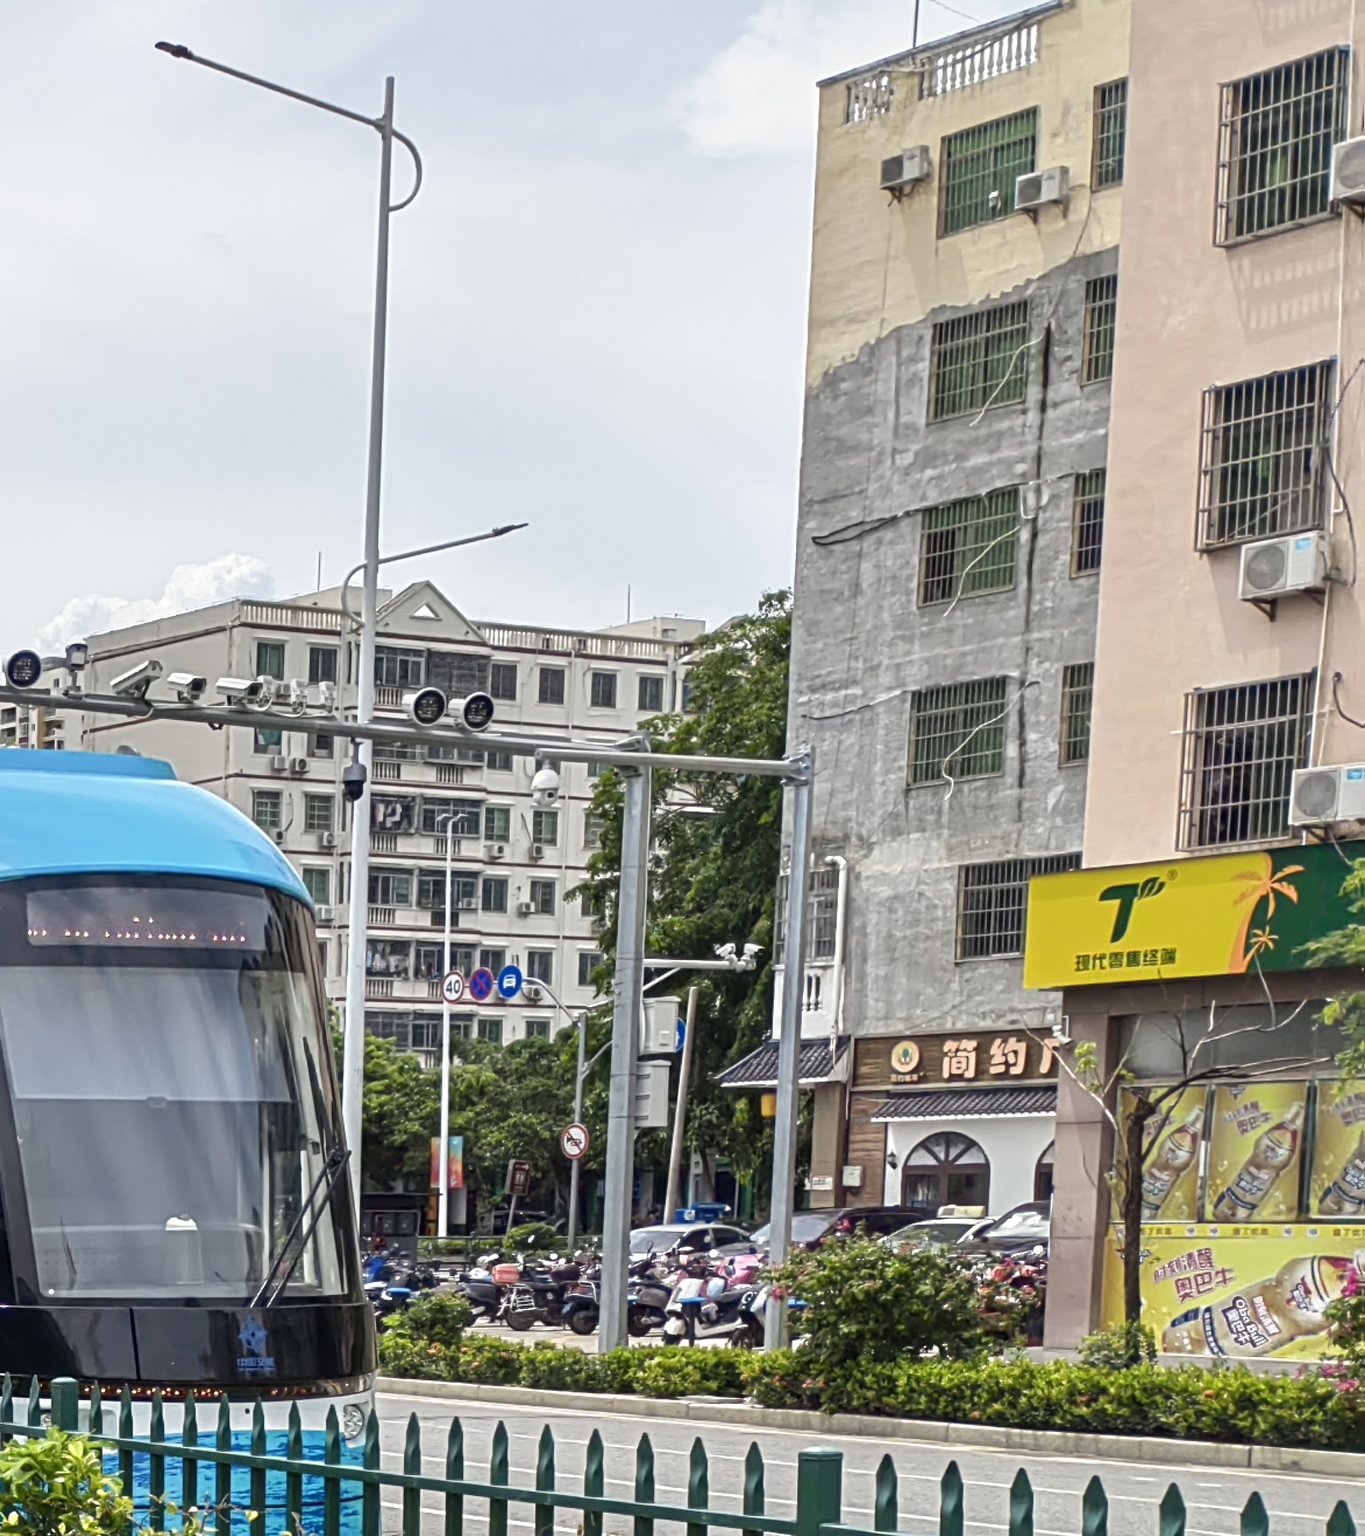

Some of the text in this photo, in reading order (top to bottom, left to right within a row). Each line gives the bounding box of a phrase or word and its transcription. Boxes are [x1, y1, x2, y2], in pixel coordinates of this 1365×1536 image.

[1074, 948, 1177, 972] 现代零售终端
[445, 979, 460, 994] 40
[1174, 1267, 1235, 1303] 奥巴牛
